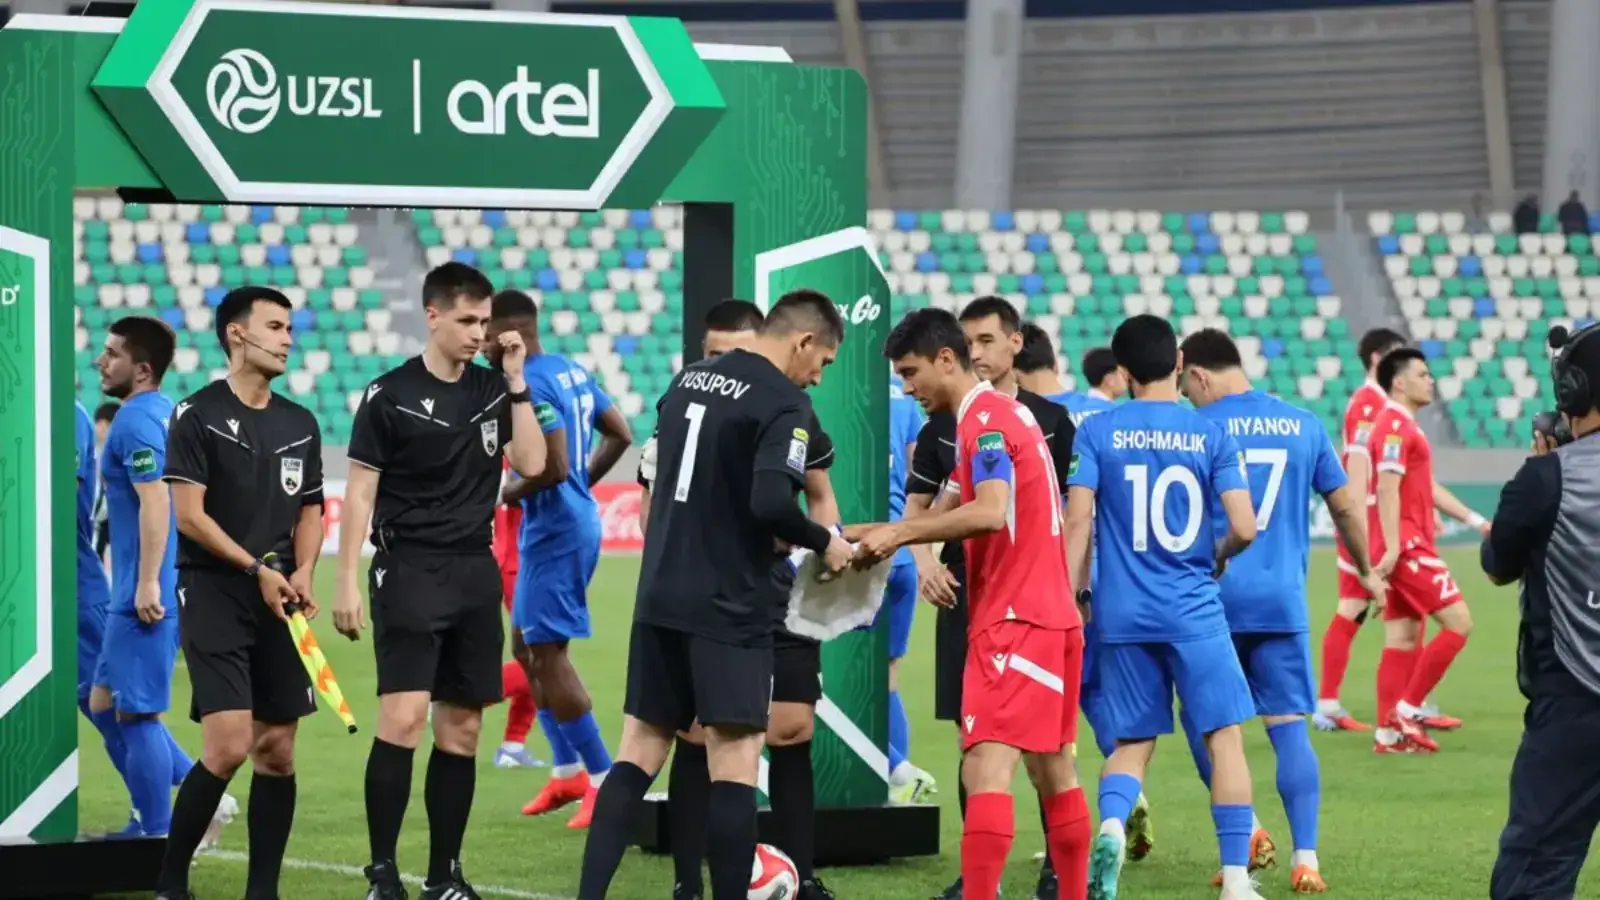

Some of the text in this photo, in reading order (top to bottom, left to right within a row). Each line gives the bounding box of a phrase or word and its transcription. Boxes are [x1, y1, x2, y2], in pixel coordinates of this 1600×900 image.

[287, 75, 383, 118] UZSL
[446, 65, 599, 138] artel
[851, 294, 881, 325] Go
[678, 371, 751, 400] YUSUPOV
[674, 402, 707, 503] 1
[1112, 430, 1207, 454] SHOHMALIK
[1124, 464, 1204, 553] 10
[1245, 448, 1288, 531] 7
